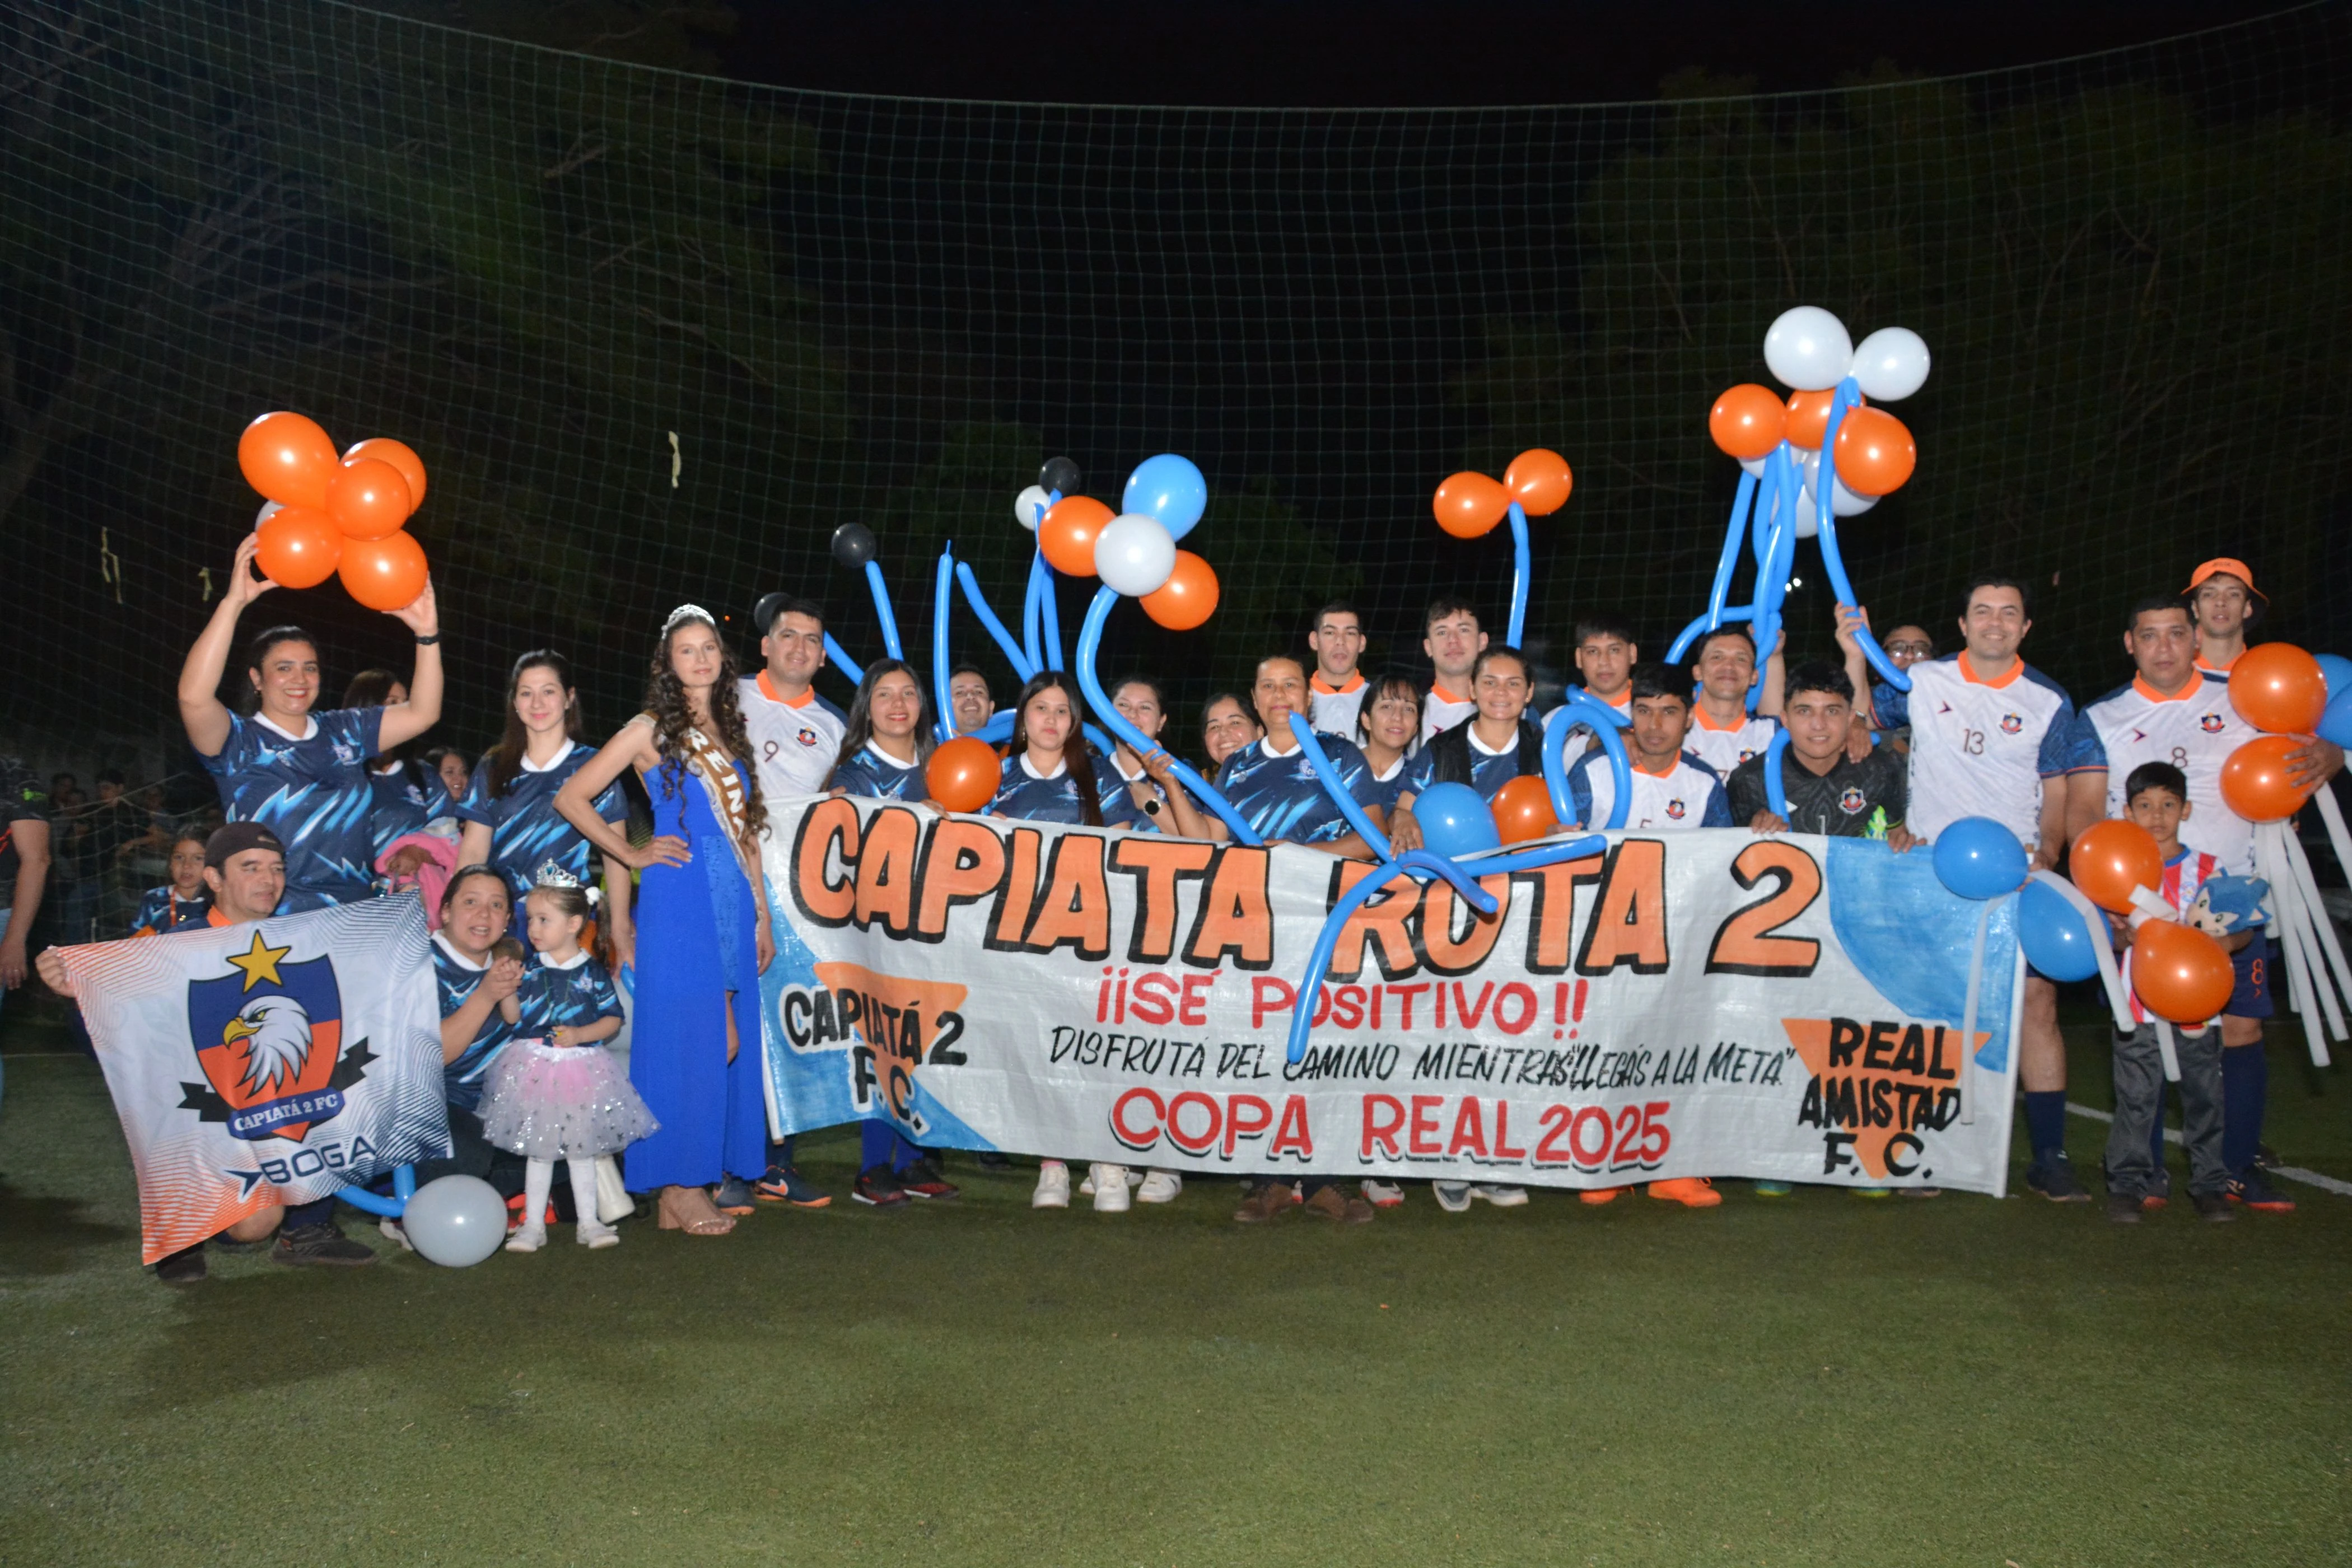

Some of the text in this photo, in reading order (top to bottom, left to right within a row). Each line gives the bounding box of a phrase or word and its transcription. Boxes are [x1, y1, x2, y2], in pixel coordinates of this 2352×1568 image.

[764, 740, 779, 763] 9
[1963, 728, 1985, 756] 13
[2171, 746, 2188, 768] 8
[790, 797, 1273, 970] CAPIATA
[1704, 841, 1822, 978] 2
[2251, 958, 2264, 985] 8
[784, 988, 968, 1066] CAPIATÁ 2
[1050, 1026, 1209, 1077] DISFRUTÁ
[1216, 1043, 1271, 1079] DEL
[1282, 1042, 1400, 1082] CAMINO
[1651, 1049, 1670, 1087] A
[1672, 1044, 1700, 1085] LA
[1830, 1017, 1956, 1080] REAL
[234, 1094, 338, 1131] CAPIATÁ 2 FC
[1109, 1088, 1671, 1173] COPA REAL 2025
[1798, 1073, 1962, 1132] AMISTAD
[260, 1135, 377, 1184] BOGA
